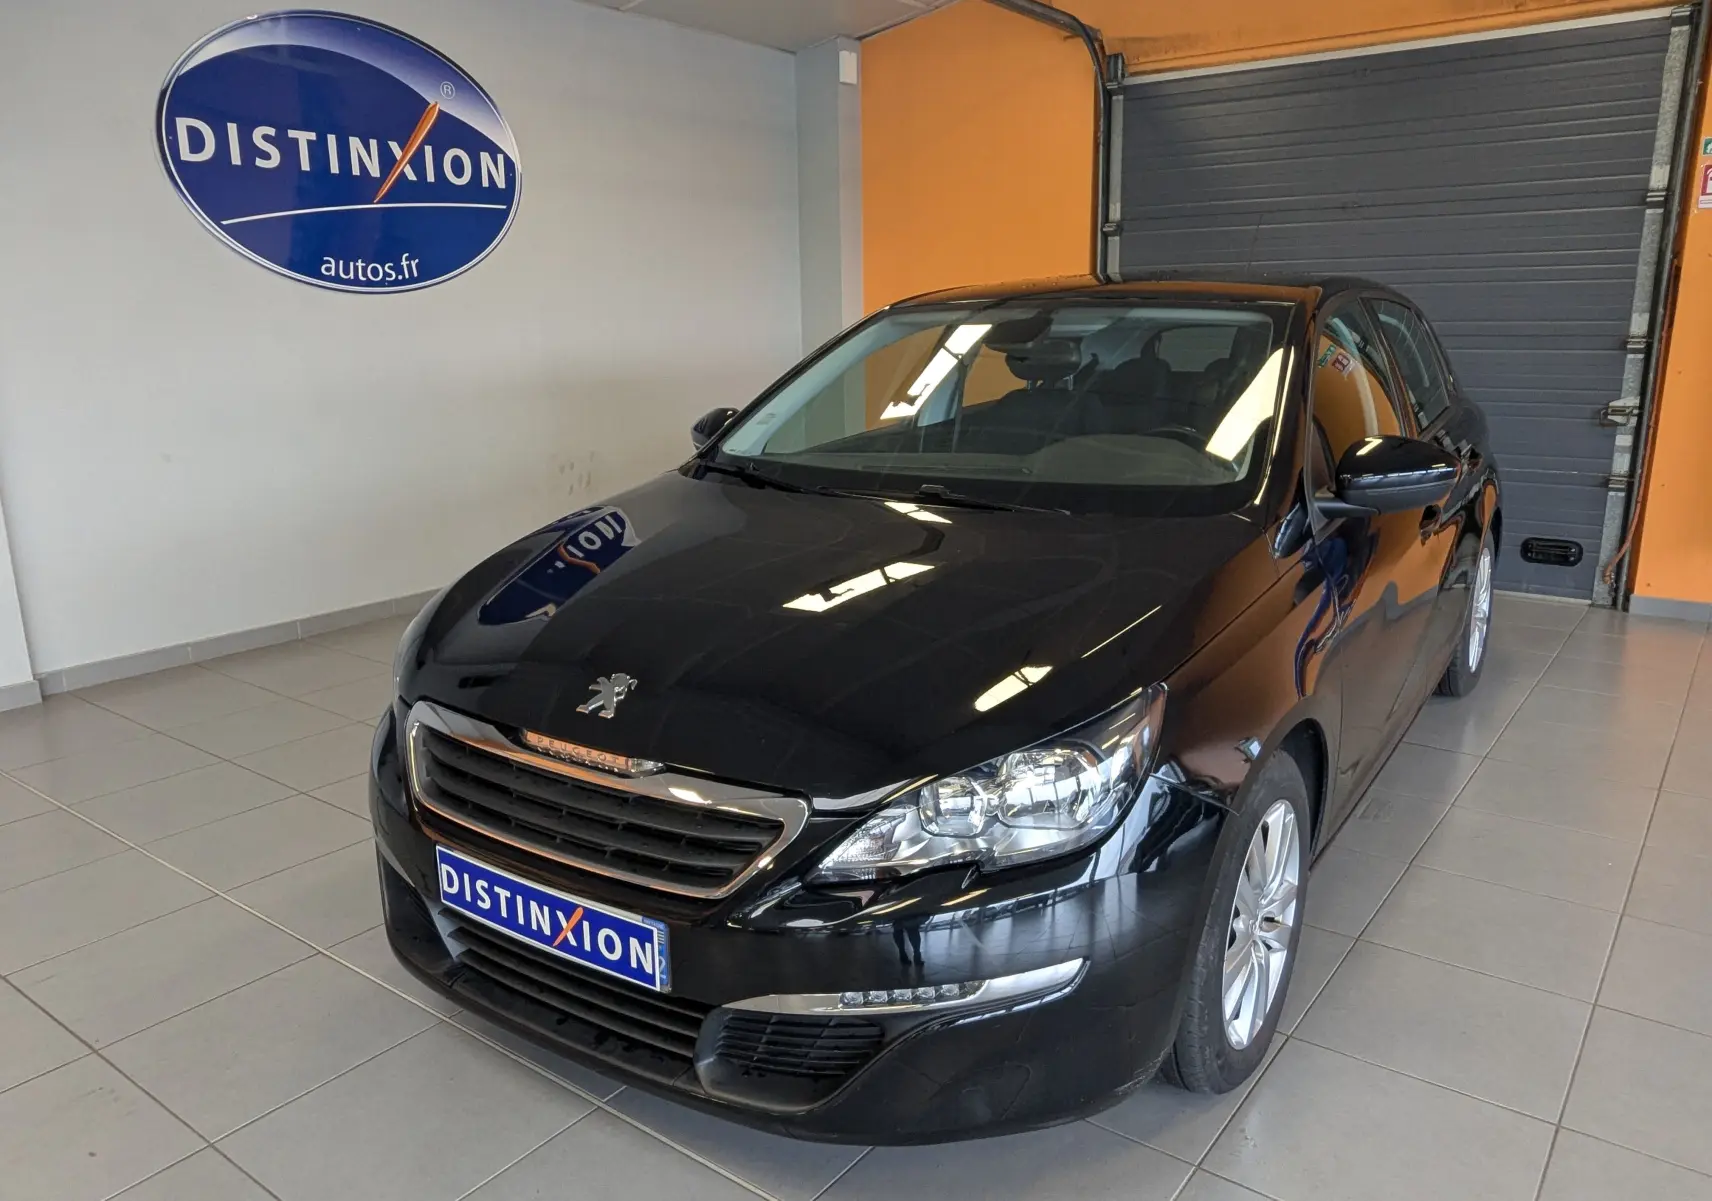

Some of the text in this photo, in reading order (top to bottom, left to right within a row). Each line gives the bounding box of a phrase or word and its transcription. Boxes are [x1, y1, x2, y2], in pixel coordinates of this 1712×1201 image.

[175, 103, 506, 202] DISTINXION
[321, 253, 419, 281] autos.fr
[537, 737, 619, 764] PEUGEOT
[440, 862, 653, 974] DISTINXION
